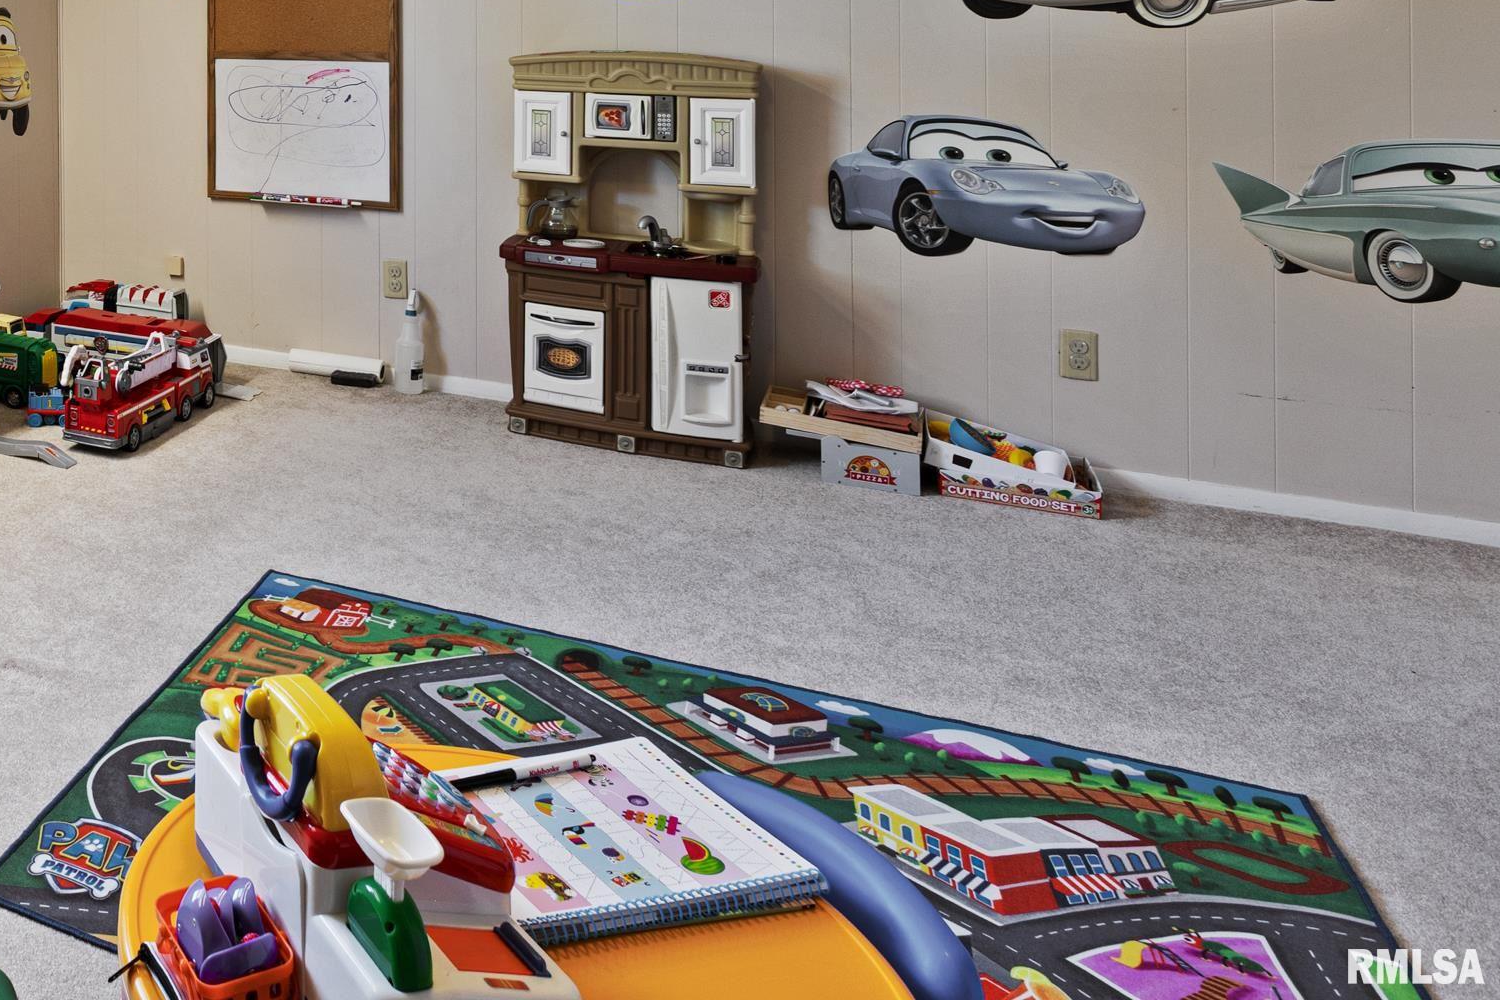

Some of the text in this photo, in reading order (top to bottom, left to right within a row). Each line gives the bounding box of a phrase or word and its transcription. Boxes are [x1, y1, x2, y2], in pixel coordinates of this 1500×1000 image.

[856, 474, 883, 483] PIZZA
[947, 485, 1077, 513] CUTTING FOOD SET
[41, 859, 106, 892] PATROL
